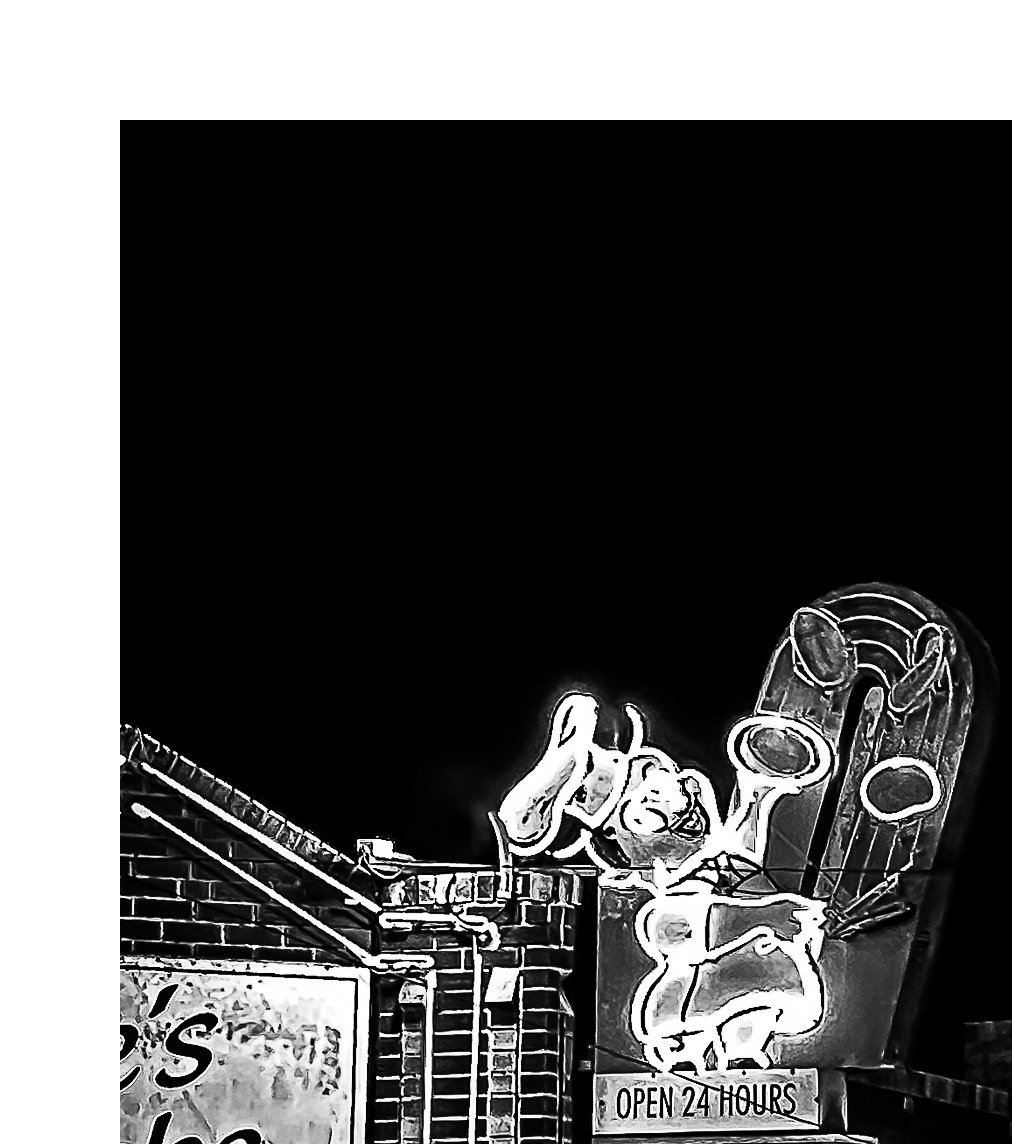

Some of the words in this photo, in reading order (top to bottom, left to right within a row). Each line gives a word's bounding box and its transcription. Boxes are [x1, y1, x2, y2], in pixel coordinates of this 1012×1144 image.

[616, 1085, 674, 1119] OPEN
[682, 1086, 710, 1118] 24
[719, 1082, 797, 1117] HOURS
